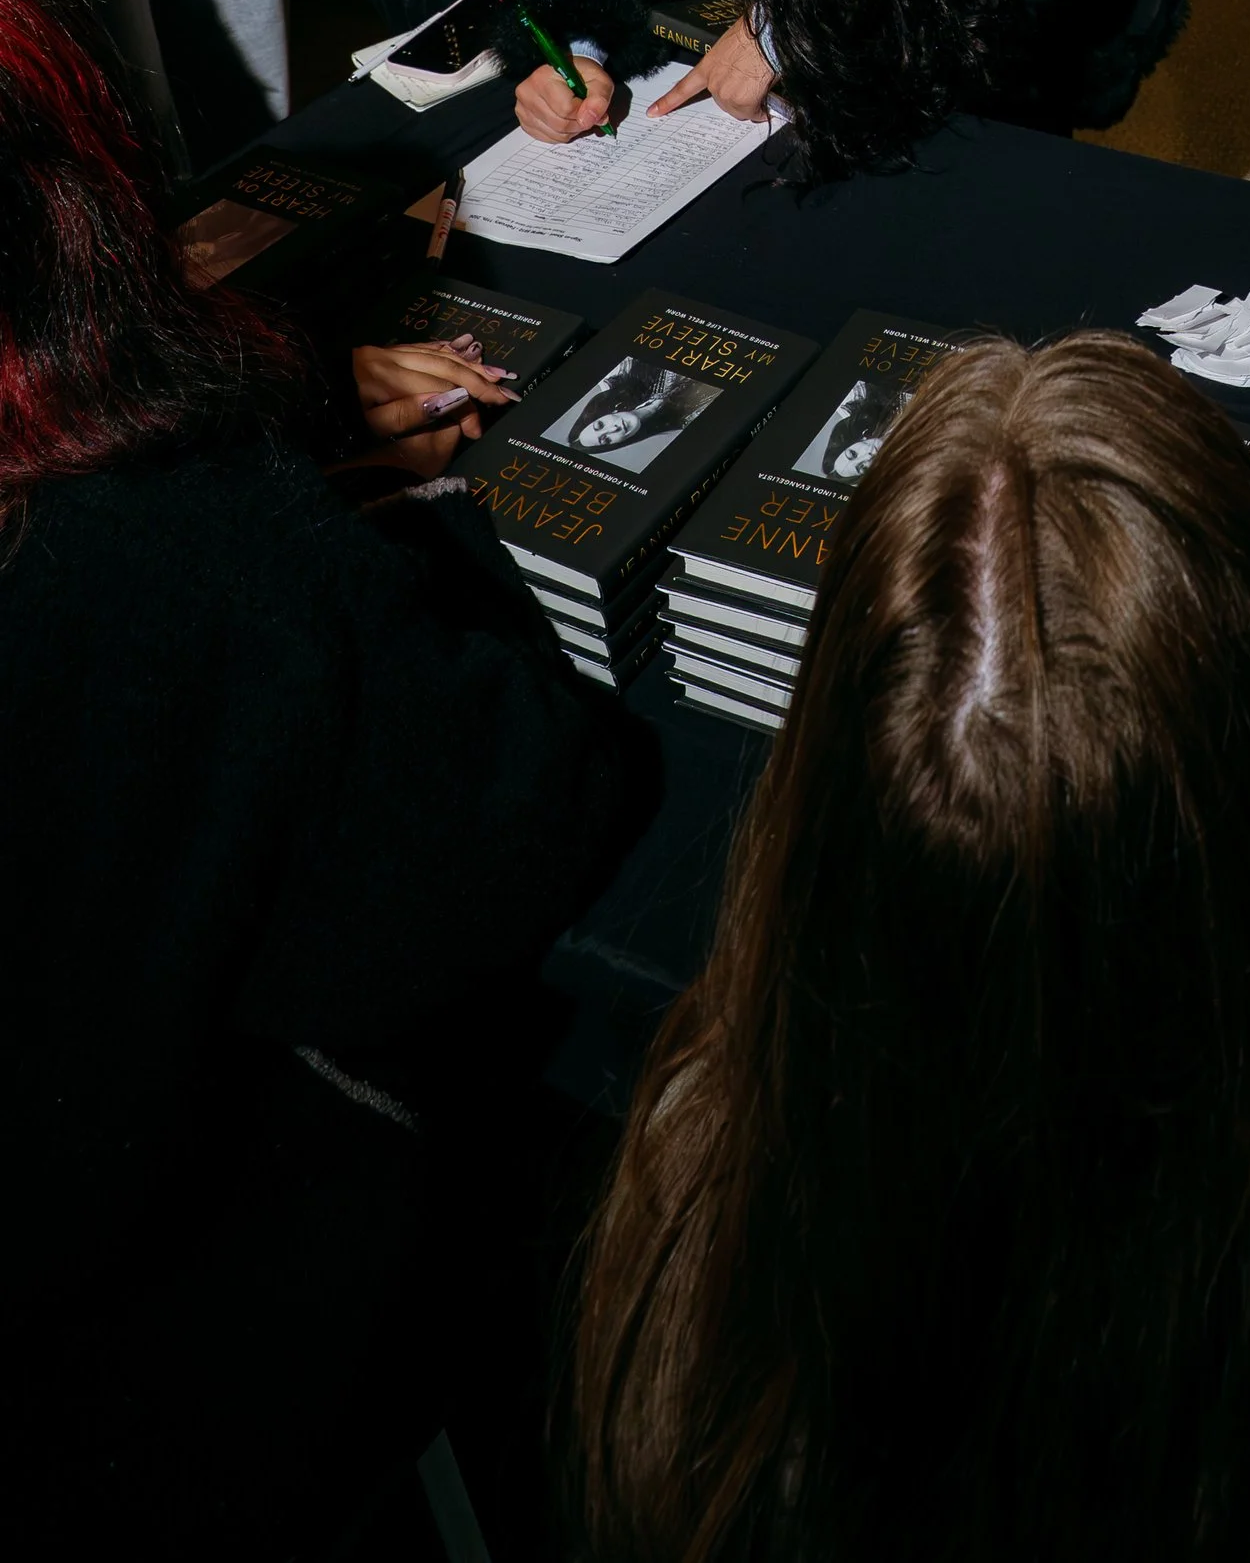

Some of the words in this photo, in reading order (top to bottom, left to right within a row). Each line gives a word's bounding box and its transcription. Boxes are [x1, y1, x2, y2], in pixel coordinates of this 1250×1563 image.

[652, 24, 700, 53] JEANNE
[257, 190, 333, 219] HEART
[453, 295, 470, 306] WELL
[470, 300, 486, 311] LIFE
[408, 295, 500, 334] SLEEVE
[491, 307, 512, 318] FROM
[512, 314, 542, 326] STORIES
[665, 308, 687, 319] WORN
[688, 315, 706, 325] WELL
[706, 321, 722, 331] LIFE
[883, 328, 907, 339] WORN
[633, 332, 664, 349] ON
[641, 315, 738, 356] SLEEVE
[728, 328, 748, 340] FROM
[910, 335, 930, 344] WELL
[749, 336, 780, 350] STORIES
[931, 340, 948, 349] LIFE
[744, 349, 776, 366] MY
[863, 337, 937, 366] EEVE
[664, 346, 753, 384] HEART
[859, 356, 892, 372] ON
[507, 438, 552, 460] EVANGELISTA
[551, 454, 573, 469] LINDA
[571, 462, 582, 471] BY
[583, 466, 623, 486] FOREWORD
[757, 472, 811, 491] EVANGELISTA
[499, 455, 618, 515] BEKER
[628, 483, 649, 496] WITH
[812, 486, 837, 498] LINDA
[837, 493, 850, 502] BY
[470, 476, 604, 545] JEANNE
[759, 491, 840, 531] KER
[720, 515, 829, 565] ANNE
